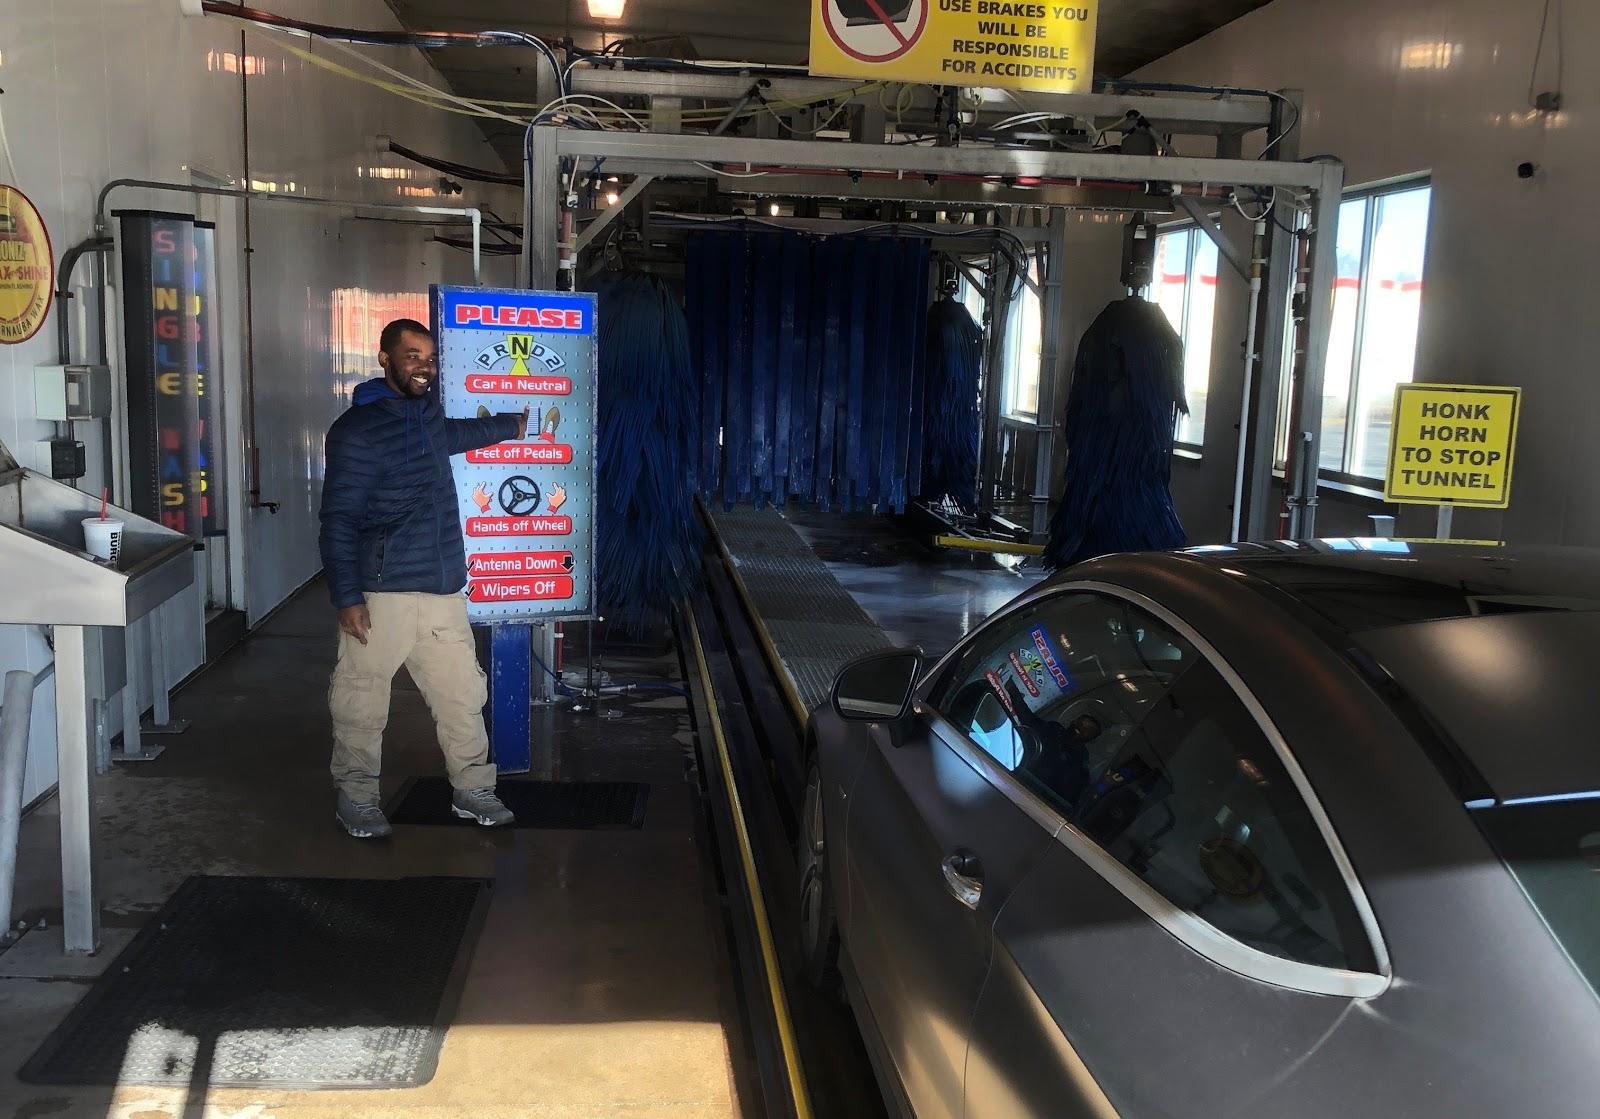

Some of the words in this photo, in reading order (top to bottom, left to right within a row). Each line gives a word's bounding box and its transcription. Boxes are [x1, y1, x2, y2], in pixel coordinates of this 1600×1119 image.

[940, 0, 971, 13] USE
[977, 1, 1046, 19] BRAKES
[1052, 7, 1089, 21] YOU
[978, 21, 1020, 37] WILL
[1025, 25, 1047, 38] BE
[953, 40, 1069, 60] RESPONSIBLE
[942, 59, 976, 74] FOR
[981, 61, 1077, 81] ACCIDENTS
[455, 304, 582, 329] PLEASE
[0, 318, 32, 337] RNAUBA
[473, 379, 497, 390] Car
[501, 379, 512, 390] in
[517, 379, 566, 391] Neutral
[1421, 402, 1491, 421] HONK
[1419, 425, 1487, 443] HORN
[475, 447, 500, 459] Feet
[503, 447, 521, 459] off
[524, 447, 563, 459] Pedals
[1401, 447, 1432, 463] TO
[1439, 448, 1501, 466] STOP
[1401, 469, 1496, 489] TUNNEL
[473, 521, 509, 533] Hands
[512, 520, 529, 532] off
[532, 519, 567, 531] Wheel
[474, 557, 522, 571] Antenna
[525, 556, 558, 570] Down
[482, 582, 530, 598] Wipers
[534, 580, 556, 594] Off
